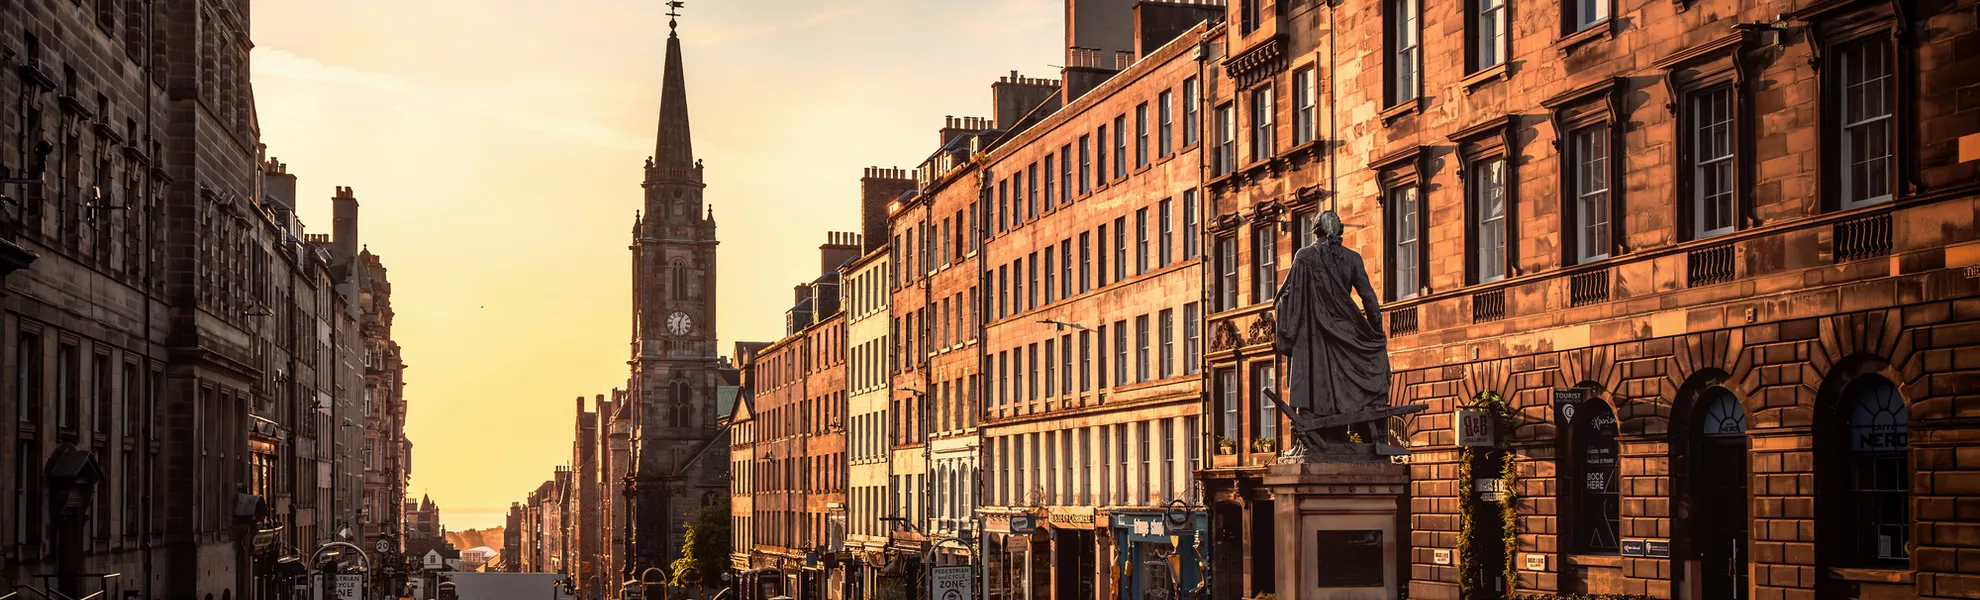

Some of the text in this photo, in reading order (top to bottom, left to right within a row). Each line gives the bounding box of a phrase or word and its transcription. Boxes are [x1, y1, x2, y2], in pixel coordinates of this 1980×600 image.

[1860, 433, 1907, 448] NERO
[1587, 480, 1604, 490] HERE
[377, 542, 388, 550] 20
[940, 580, 965, 589] ZONE
